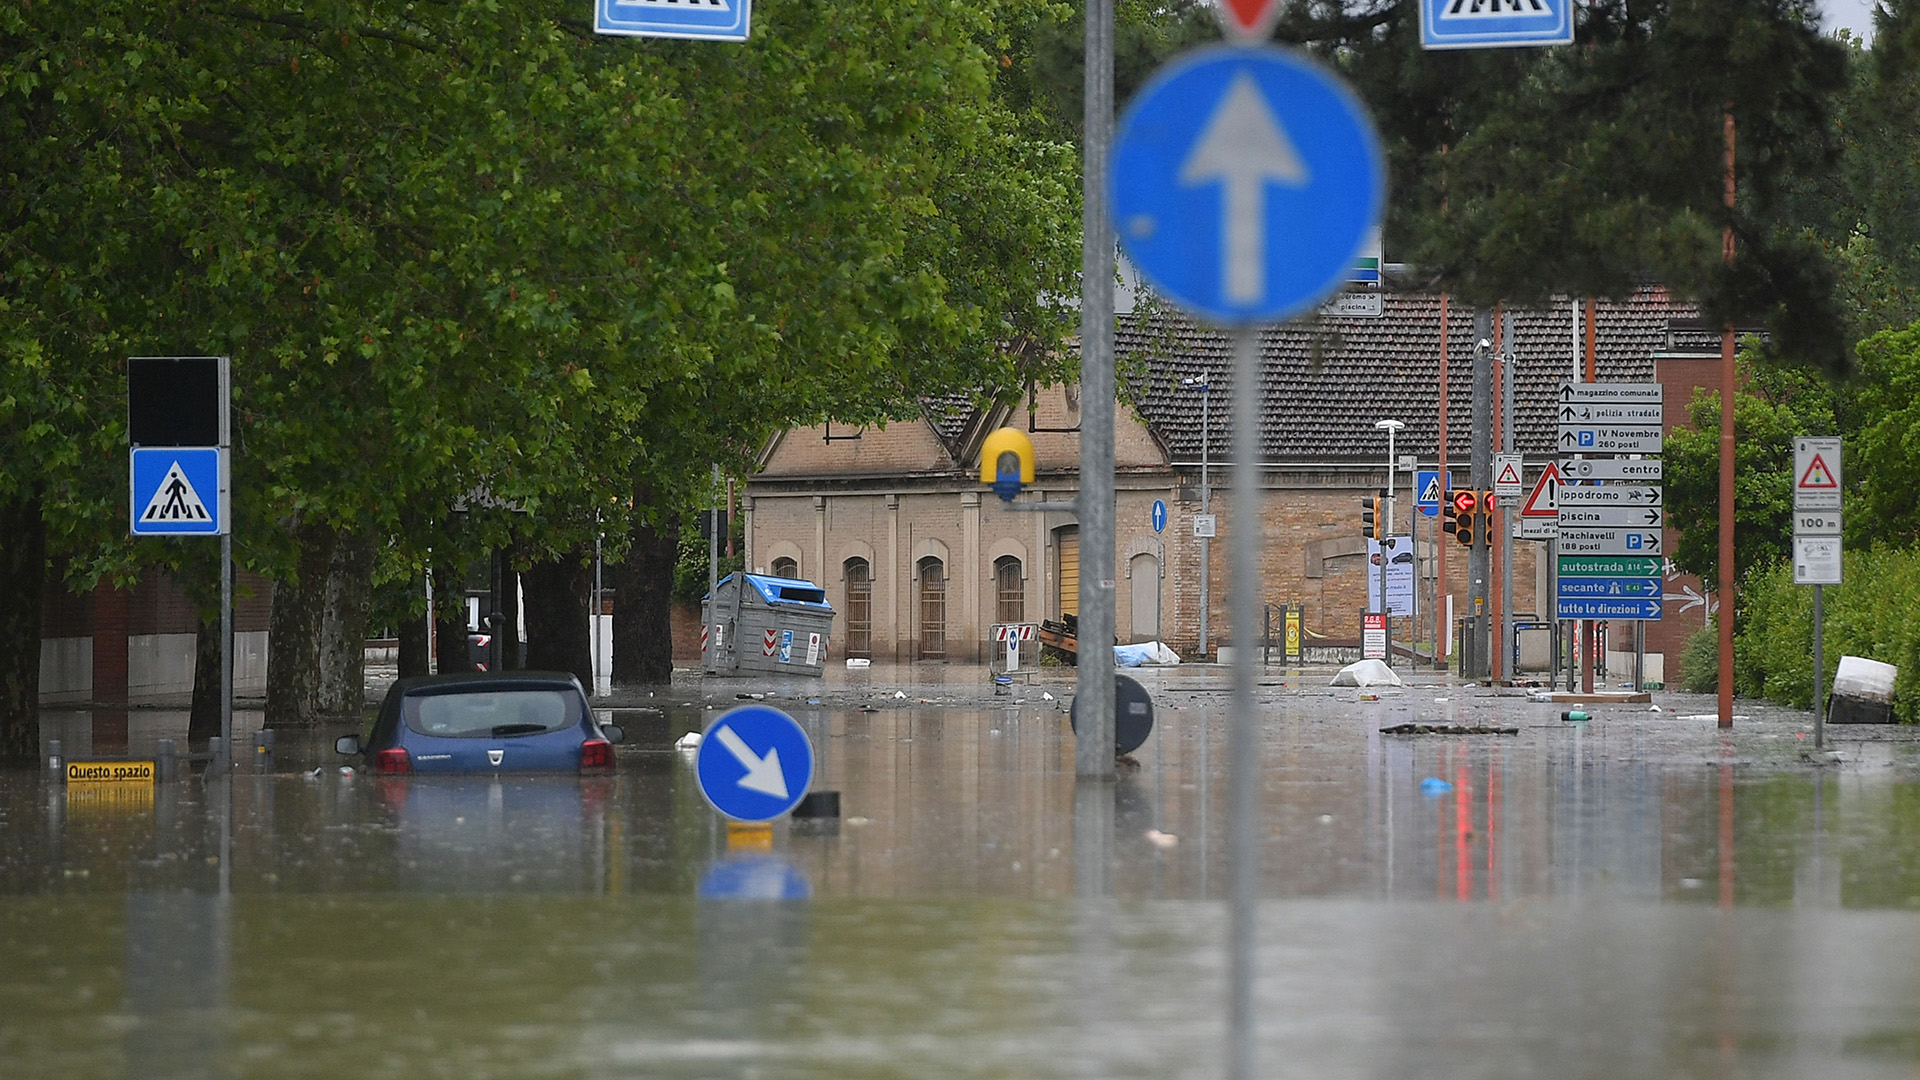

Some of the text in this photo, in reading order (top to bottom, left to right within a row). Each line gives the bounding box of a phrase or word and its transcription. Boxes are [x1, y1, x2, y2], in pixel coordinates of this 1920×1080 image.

[1577, 389, 1659, 398] magazzino comunale
[1596, 409, 1660, 418] polizia stradale
[1581, 430, 1660, 444] P IV Novembre
[1598, 440, 1639, 449] 260 posti
[1622, 465, 1660, 474] centro
[1560, 489, 1619, 500] ippodromo
[1560, 511, 1600, 522] piscina
[1801, 518, 1836, 528] 100 m
[1561, 531, 1615, 540] Machiavelli
[1629, 535, 1639, 548] P
[1579, 543, 1601, 551] posti
[1562, 562, 1640, 572] autostrada A14
[1562, 583, 1605, 592] secante
[1558, 603, 1640, 614] tutte le direzioni
[69, 764, 150, 781] Questo spazio
